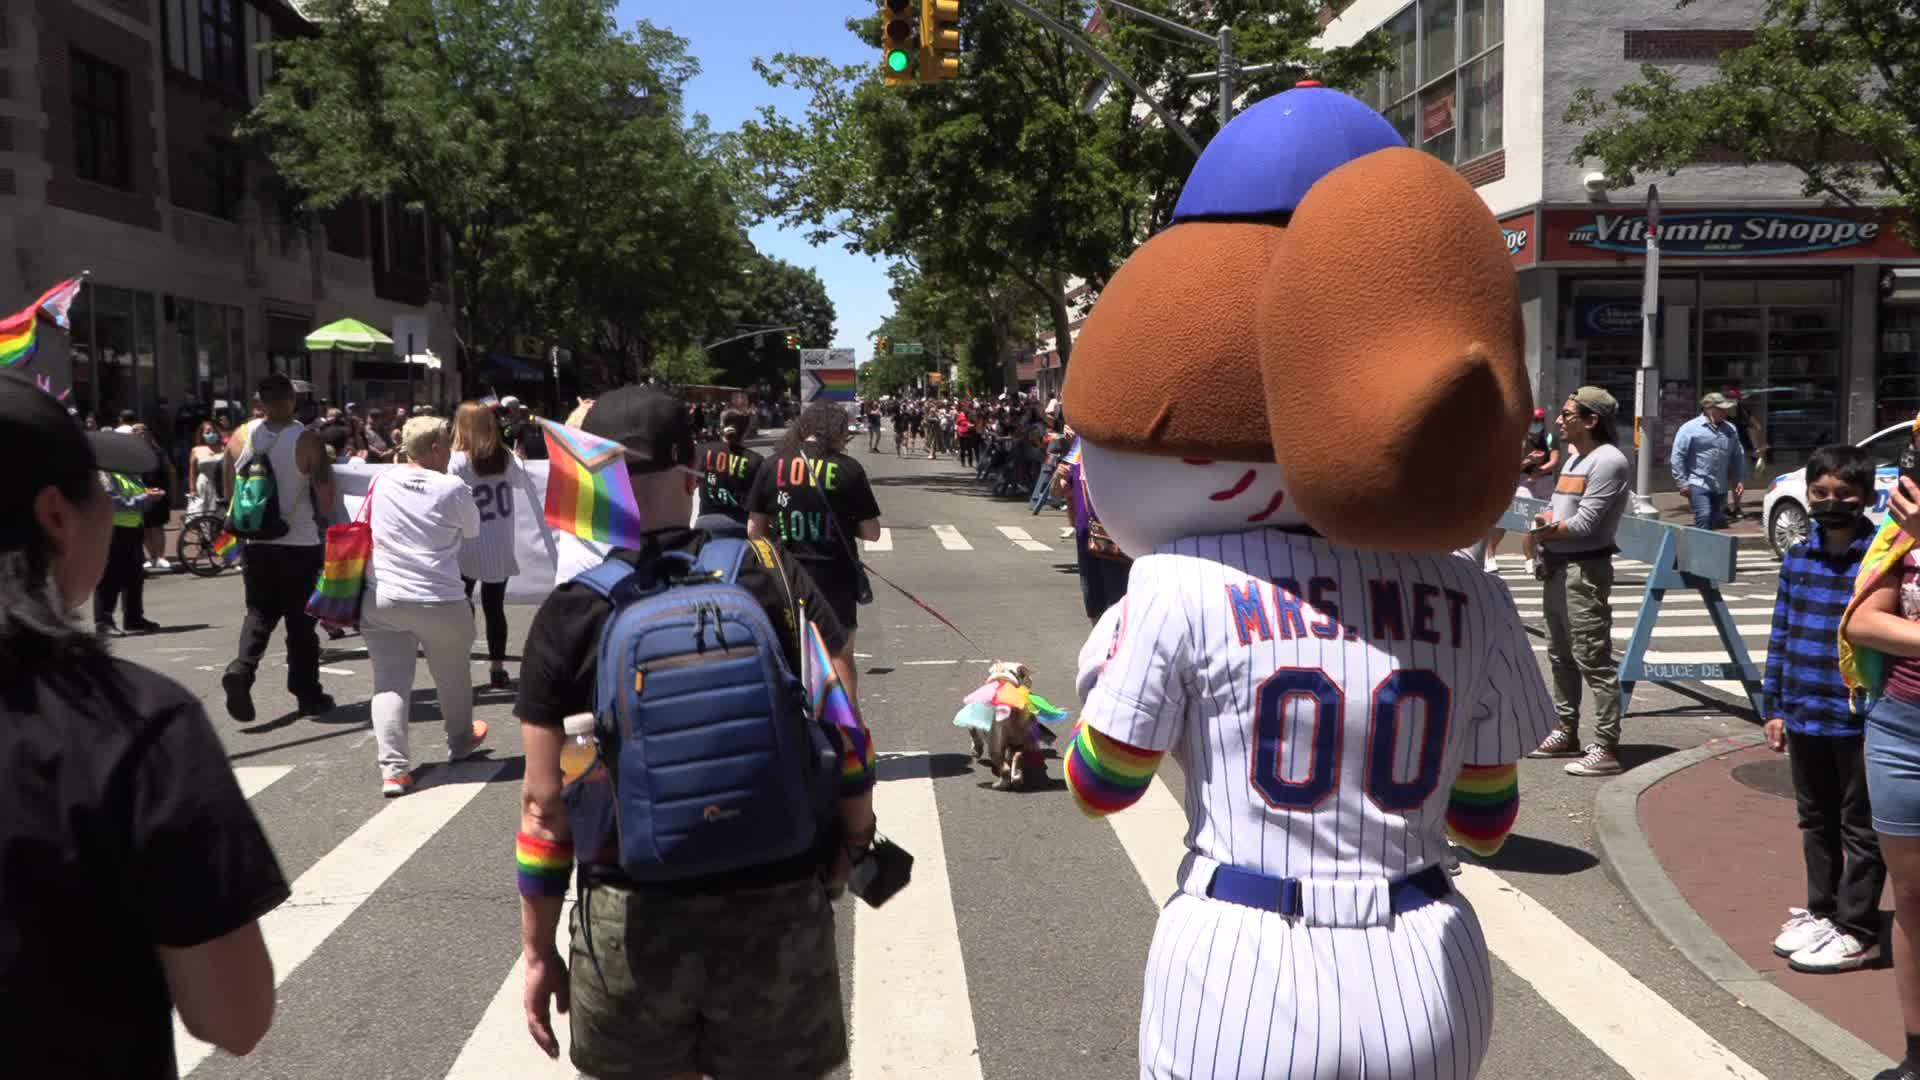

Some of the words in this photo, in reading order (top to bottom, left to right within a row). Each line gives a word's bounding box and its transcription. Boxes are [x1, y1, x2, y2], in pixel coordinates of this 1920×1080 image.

[1568, 232, 1593, 241] THE
[1740, 217, 1880, 244] Shoppe
[706, 450, 750, 478] LOVE
[776, 456, 839, 490] LOVE
[472, 481, 513, 522] 20
[777, 490, 791, 508] is
[1224, 576, 1361, 648] MRS.
[1367, 576, 1468, 649] MET
[1644, 663, 1694, 678] POLICE
[1250, 666, 1452, 813] 00
